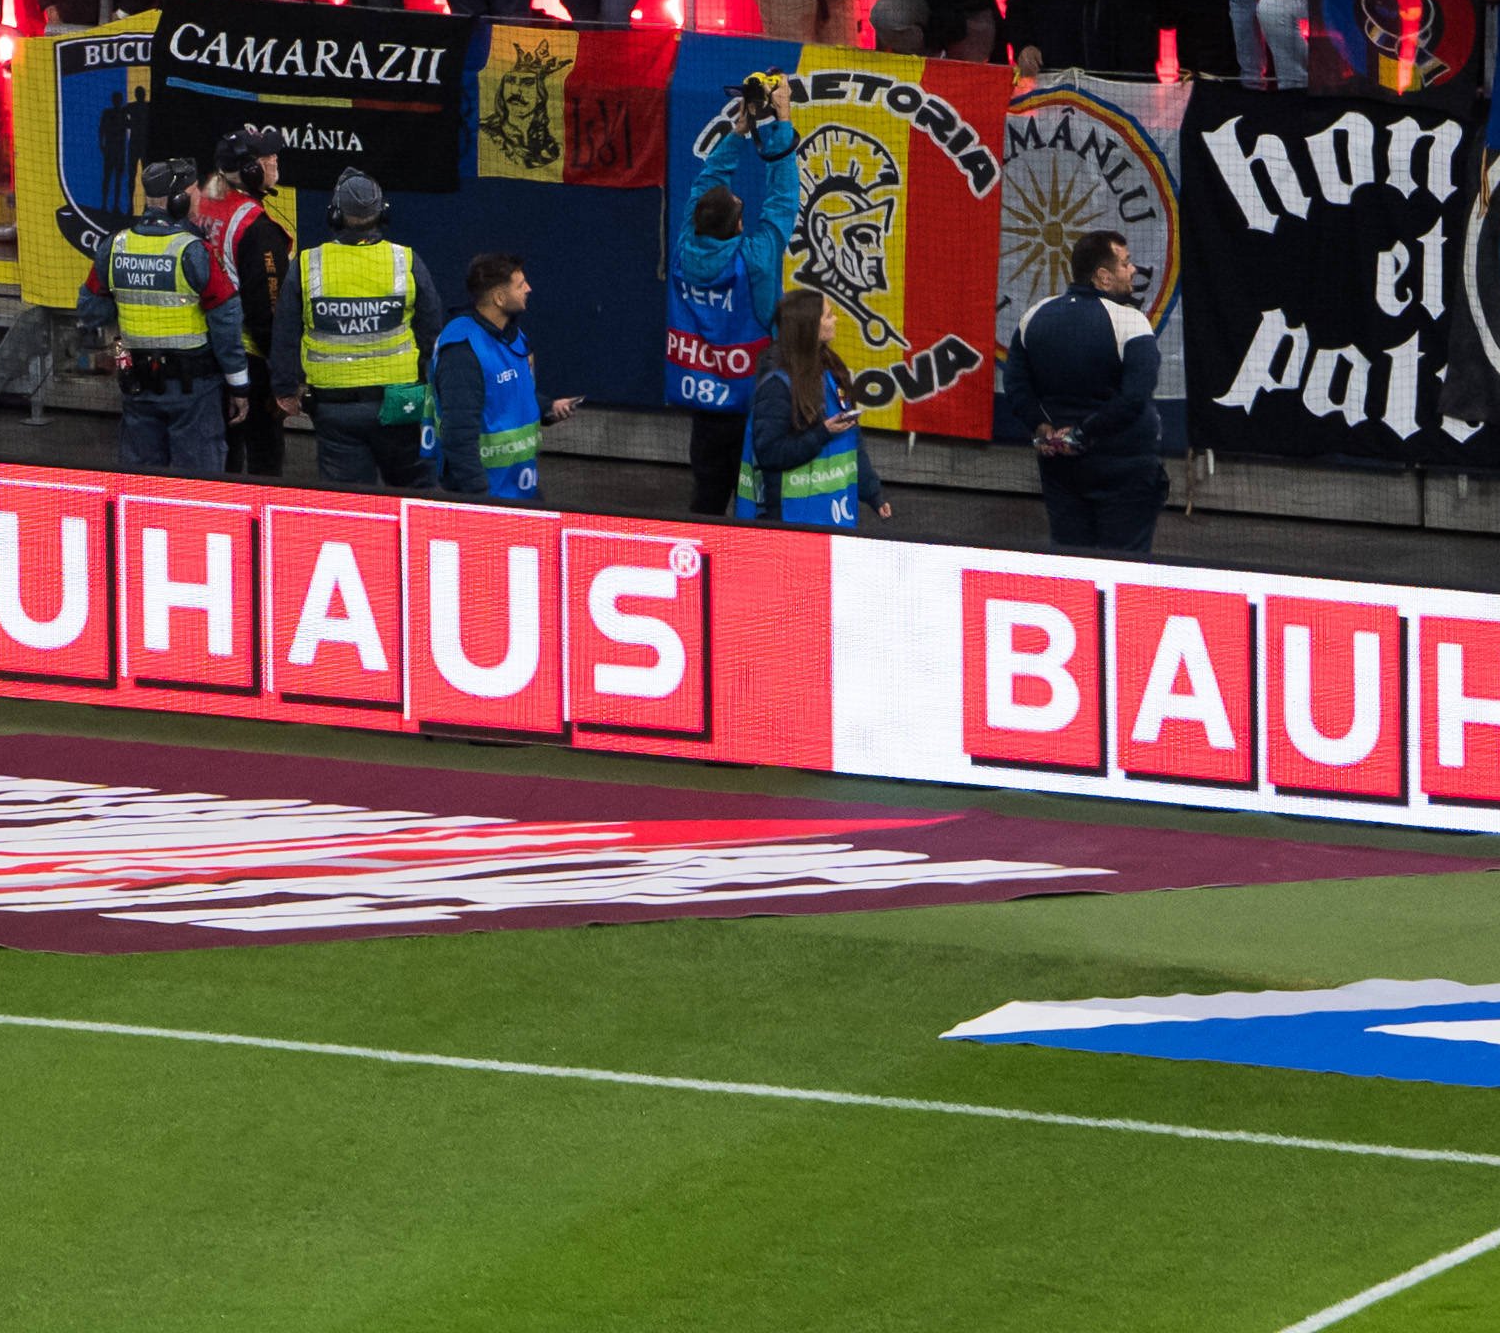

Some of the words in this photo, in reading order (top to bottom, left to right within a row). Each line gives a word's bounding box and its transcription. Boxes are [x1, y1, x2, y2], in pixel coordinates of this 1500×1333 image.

[169, 21, 442, 85] CAMARAZII
[114, 257, 173, 273] ORDNINGS
[126, 272, 156, 288] VAKT
[681, 376, 730, 406] 087
